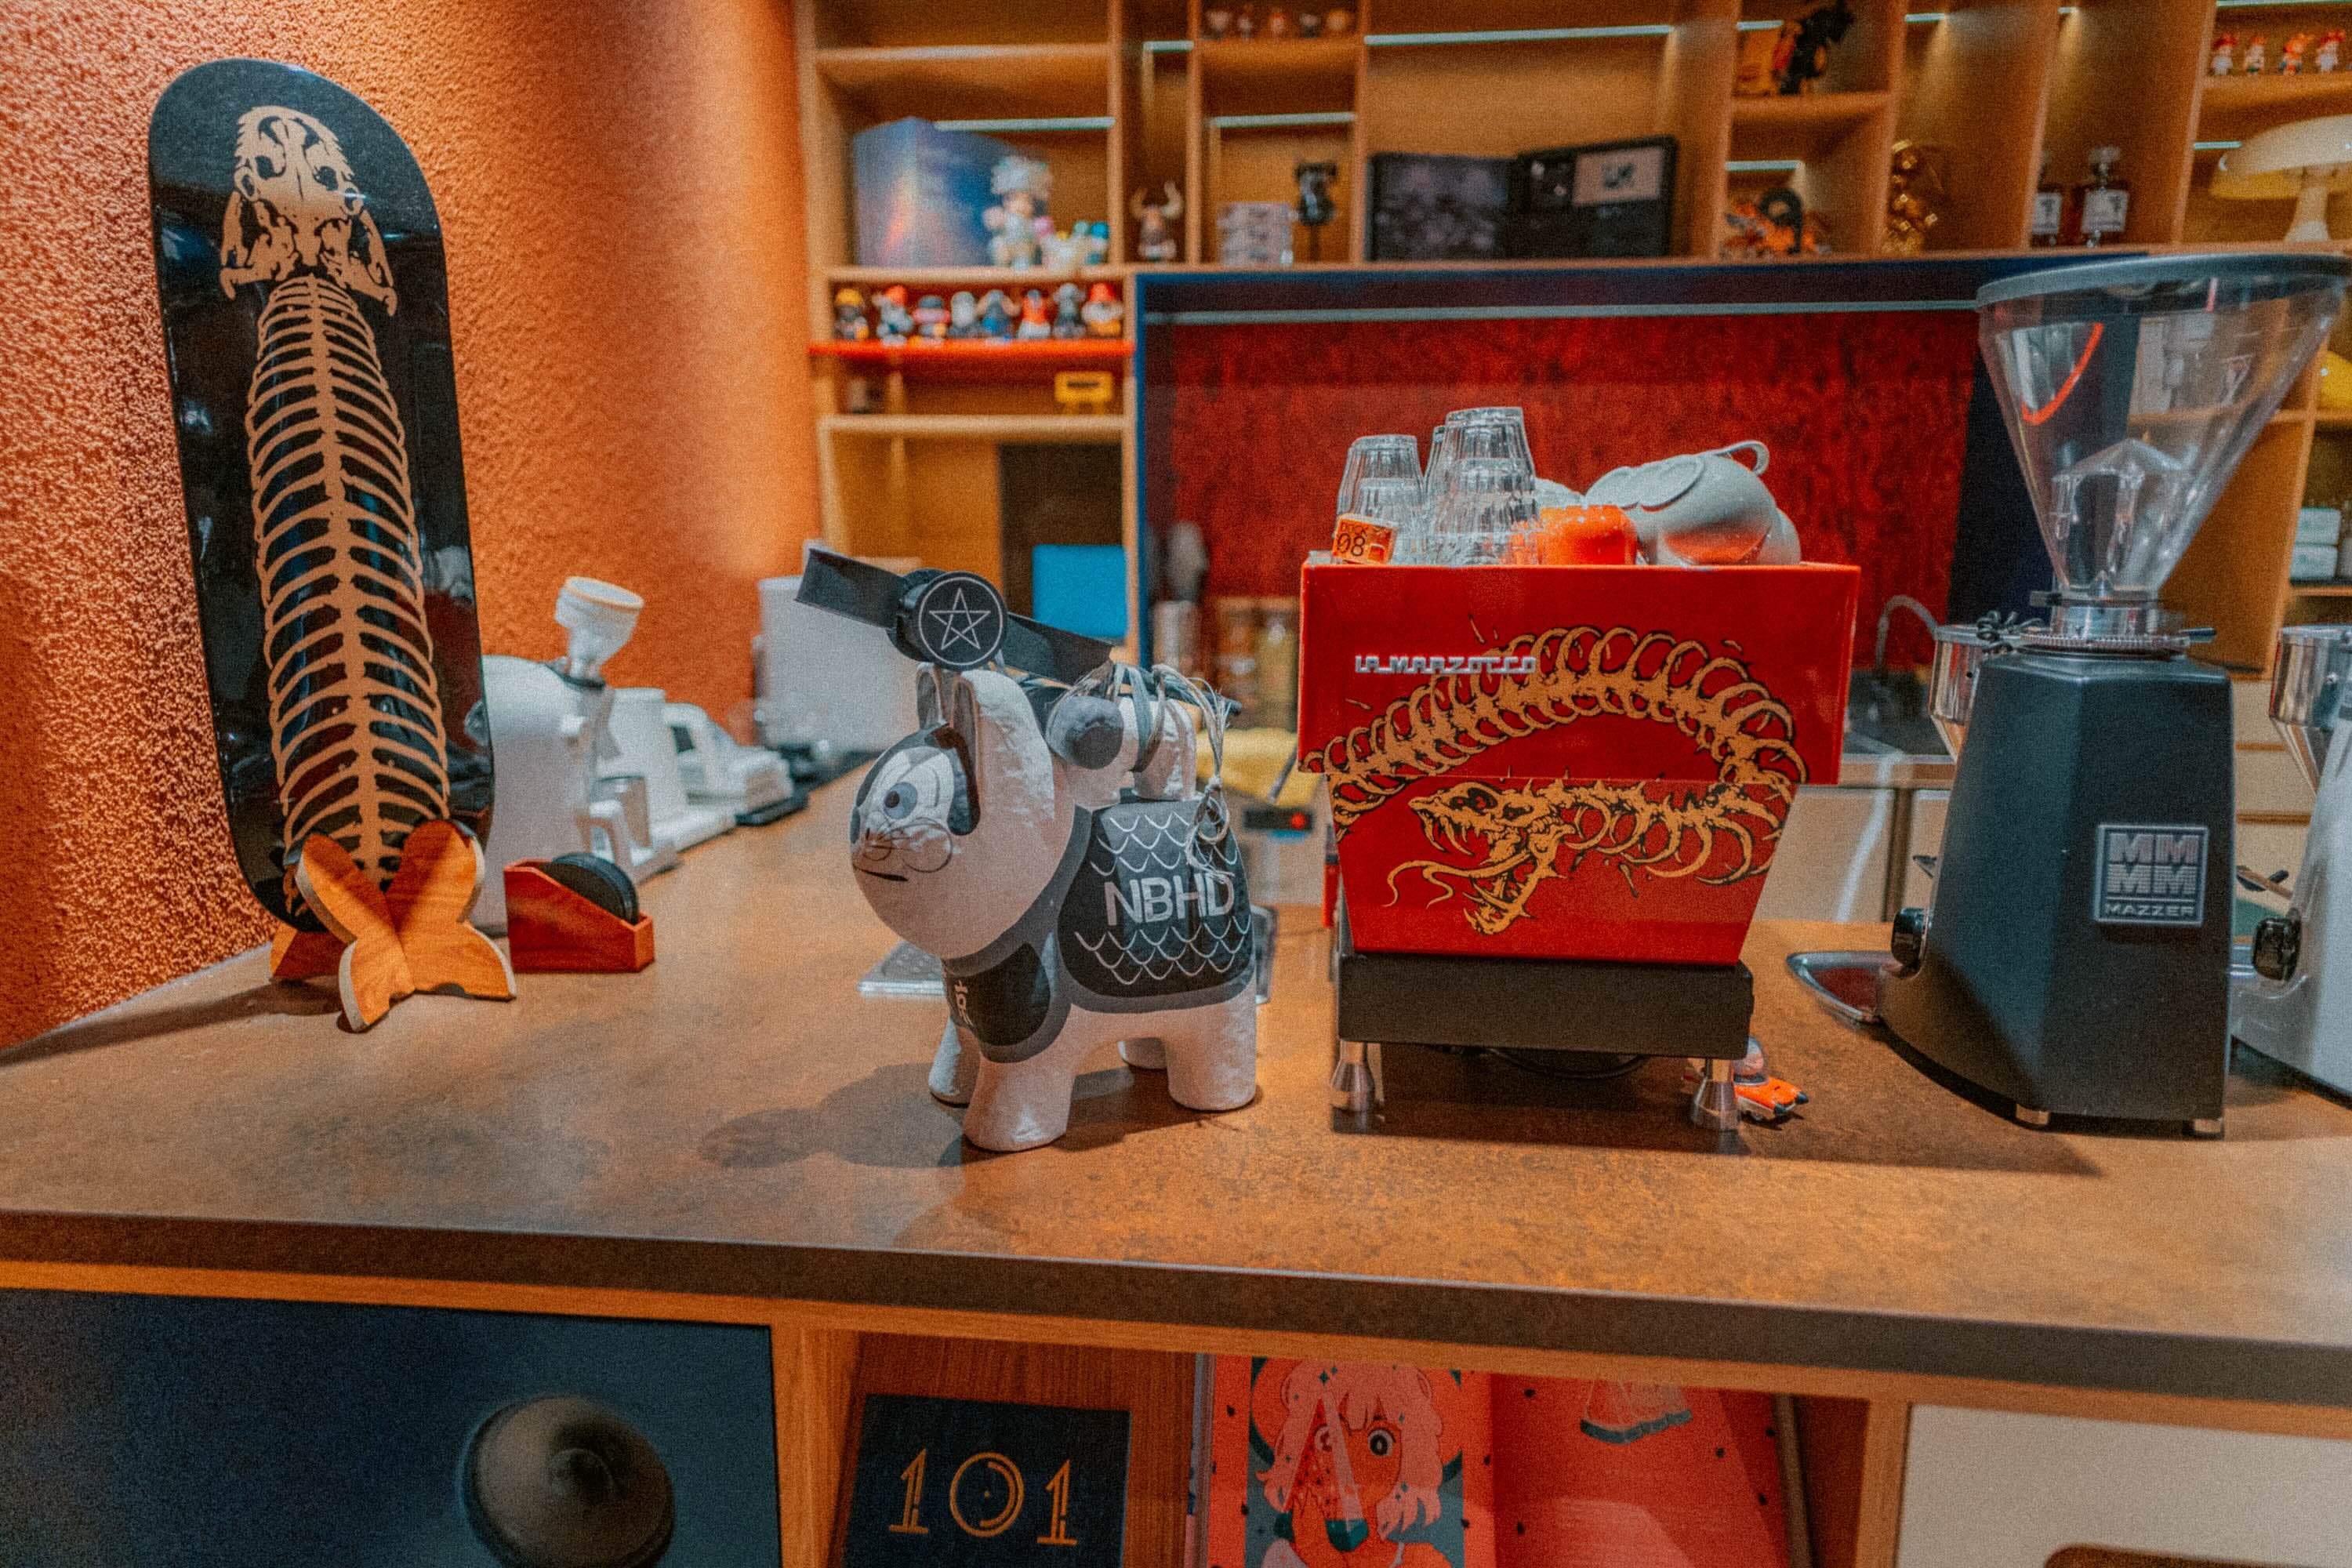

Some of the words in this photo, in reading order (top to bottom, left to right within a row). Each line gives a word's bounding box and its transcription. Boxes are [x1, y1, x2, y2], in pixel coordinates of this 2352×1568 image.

[1104, 872, 1235, 927] NBHD
[2103, 903, 2194, 917] MAZZER
[888, 1447, 1079, 1547] 101
